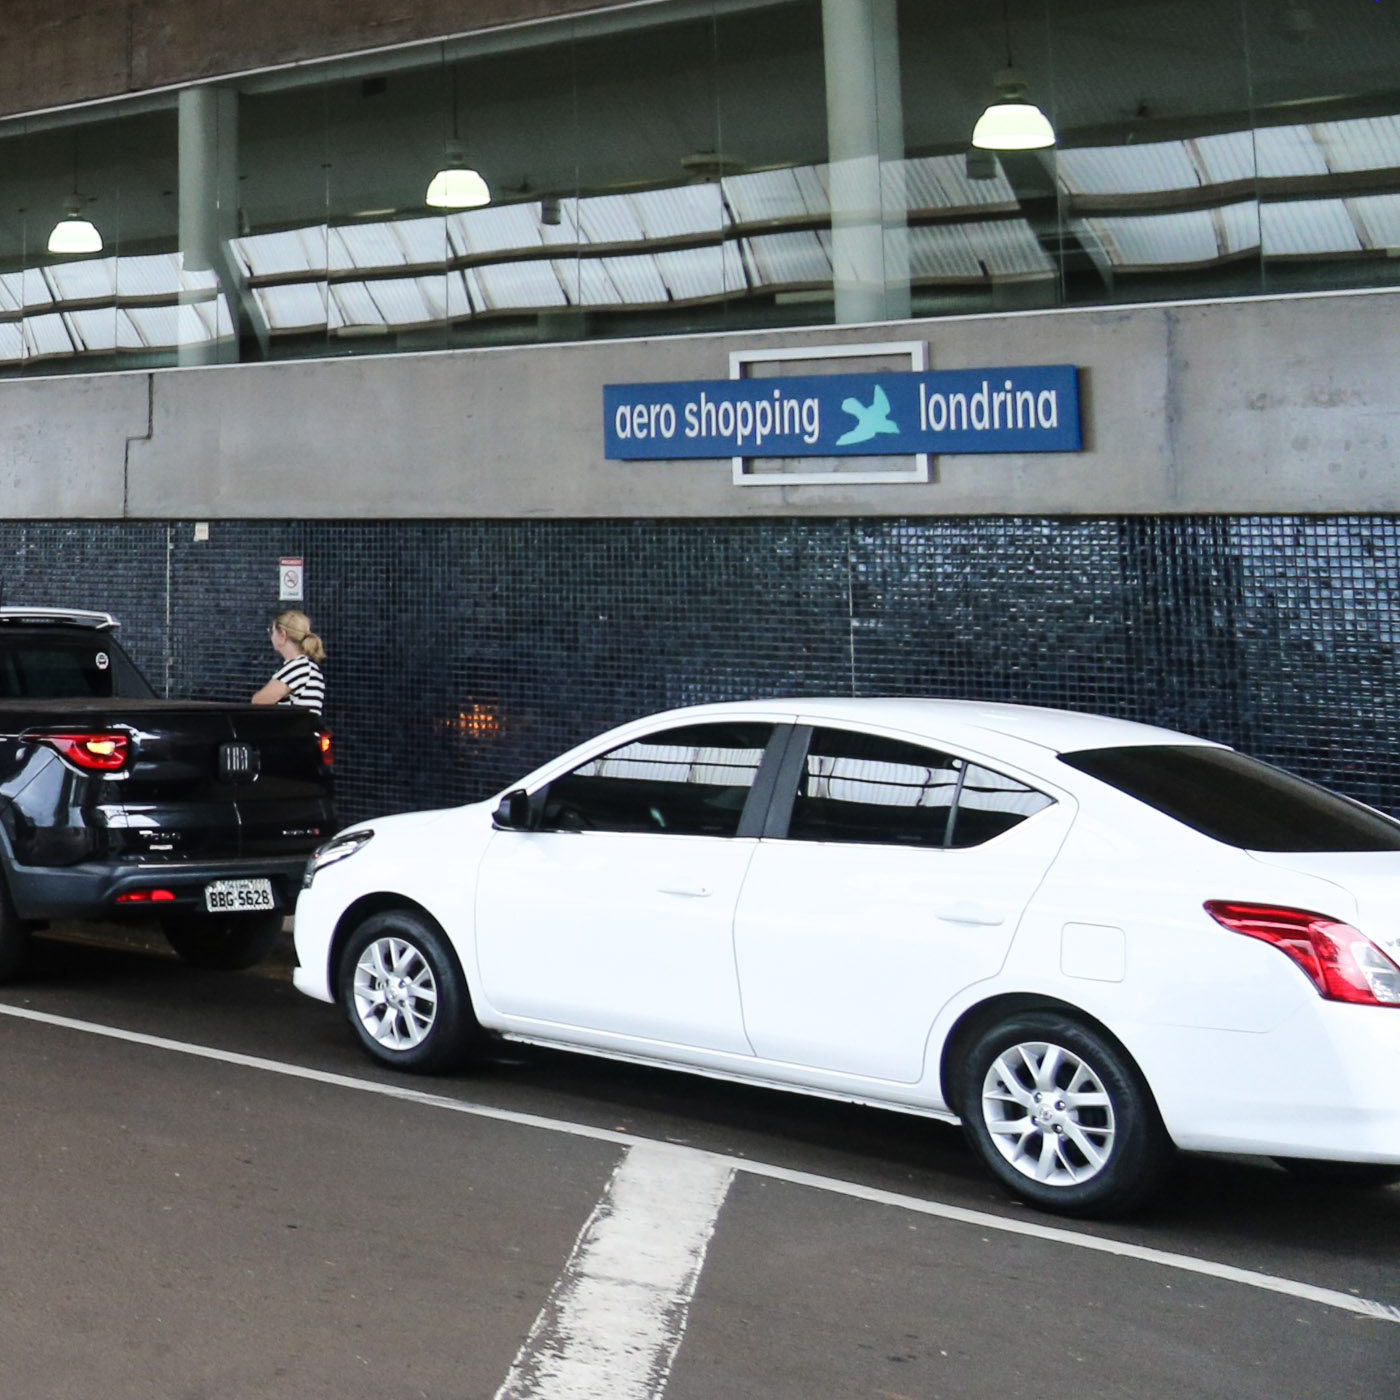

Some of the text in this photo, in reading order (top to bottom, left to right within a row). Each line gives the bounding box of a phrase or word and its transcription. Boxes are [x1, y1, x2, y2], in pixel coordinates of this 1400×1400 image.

[615, 380, 1058, 446] aero shopping londrina
